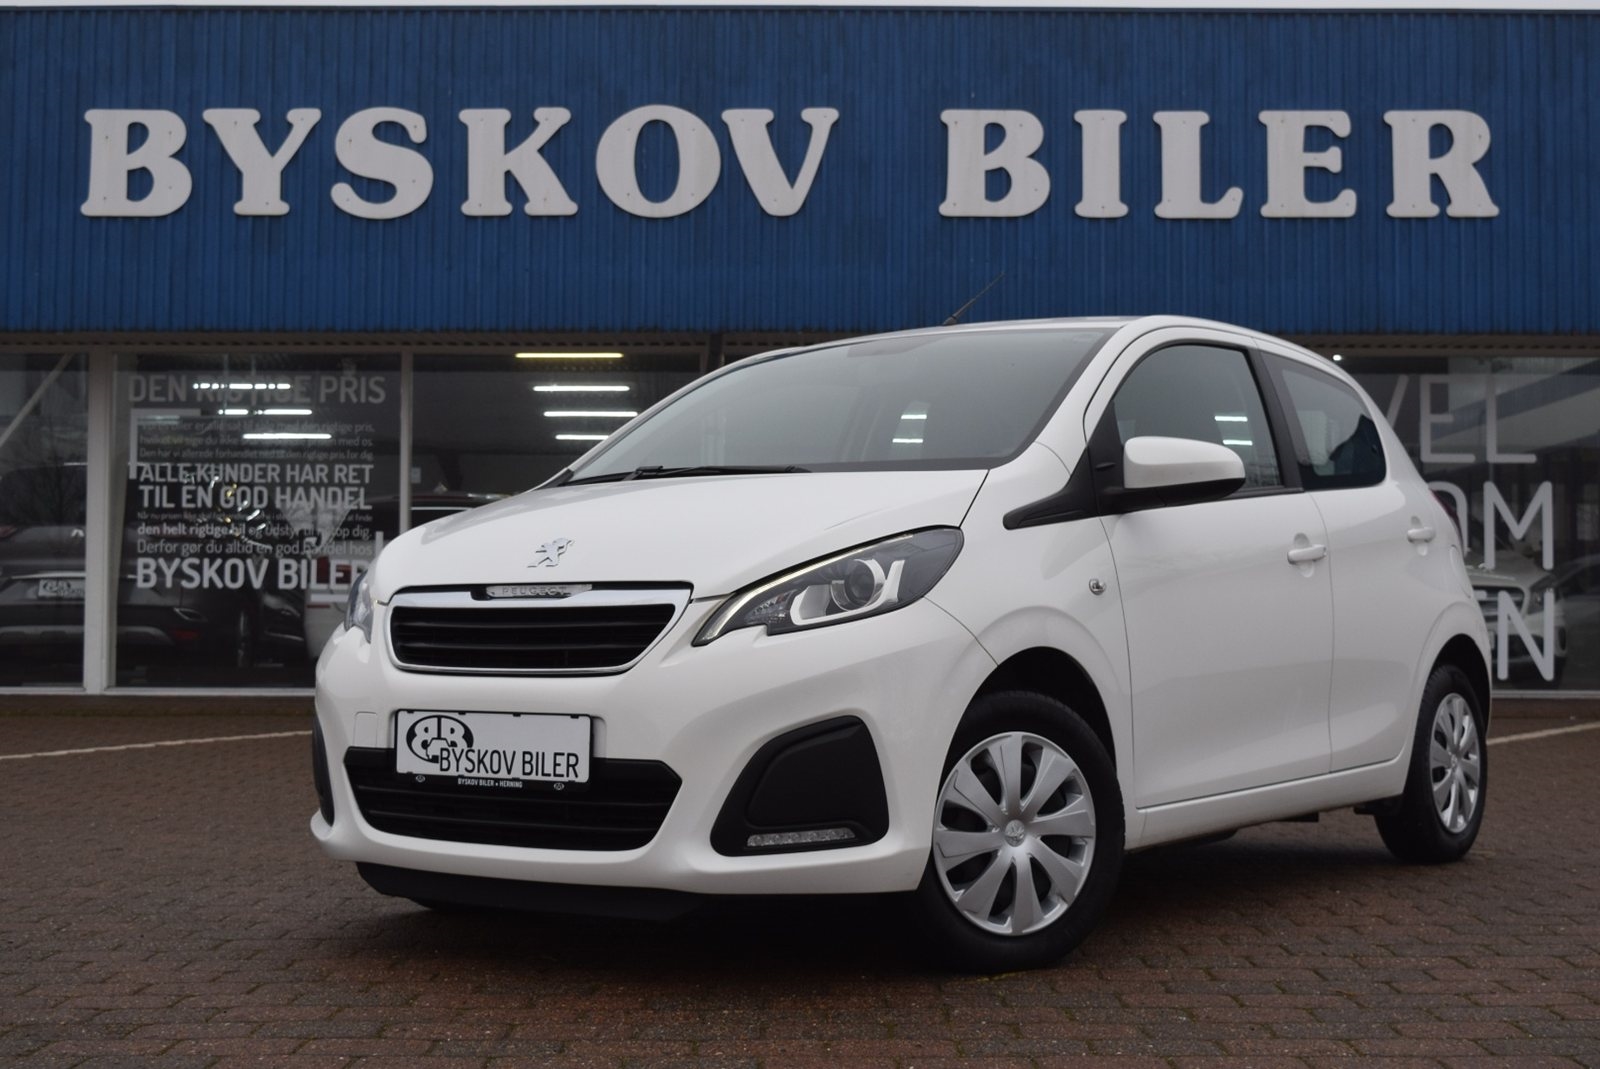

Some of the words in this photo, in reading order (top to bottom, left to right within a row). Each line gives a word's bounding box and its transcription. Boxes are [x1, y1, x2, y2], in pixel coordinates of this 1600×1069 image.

[81, 106, 839, 219] BYSKOV
[939, 108, 1500, 219] BILER
[128, 374, 187, 402] DEN
[319, 375, 386, 404] PRIS
[139, 463, 188, 483] ALLE
[194, 463, 281, 484] KUNDER
[286, 463, 329, 484] HAR
[333, 464, 375, 485] RET
[138, 485, 176, 509] TIL
[181, 485, 213, 509] EN
[219, 486, 269, 509] GOD
[275, 486, 373, 510] HANDEL
[137, 521, 161, 535] den
[162, 521, 187, 535] helt
[189, 522, 229, 539] rigtige
[352, 525, 373, 541] dig.
[137, 538, 178, 554] Derfor
[181, 541, 202, 558] gør
[205, 540, 223, 554] du
[225, 540, 253, 554] altid
[275, 541, 300, 558] god
[349, 542, 373, 555] hos
[136, 557, 269, 590] BYSKOV
[502, 586, 567, 595] PEUGEOT
[439, 747, 517, 775] BYSKOV
[522, 751, 580, 779] BILER
[457, 778, 479, 786] BYSKOV
[479, 779, 495, 787] BILER
[499, 780, 523, 789] HERNING
